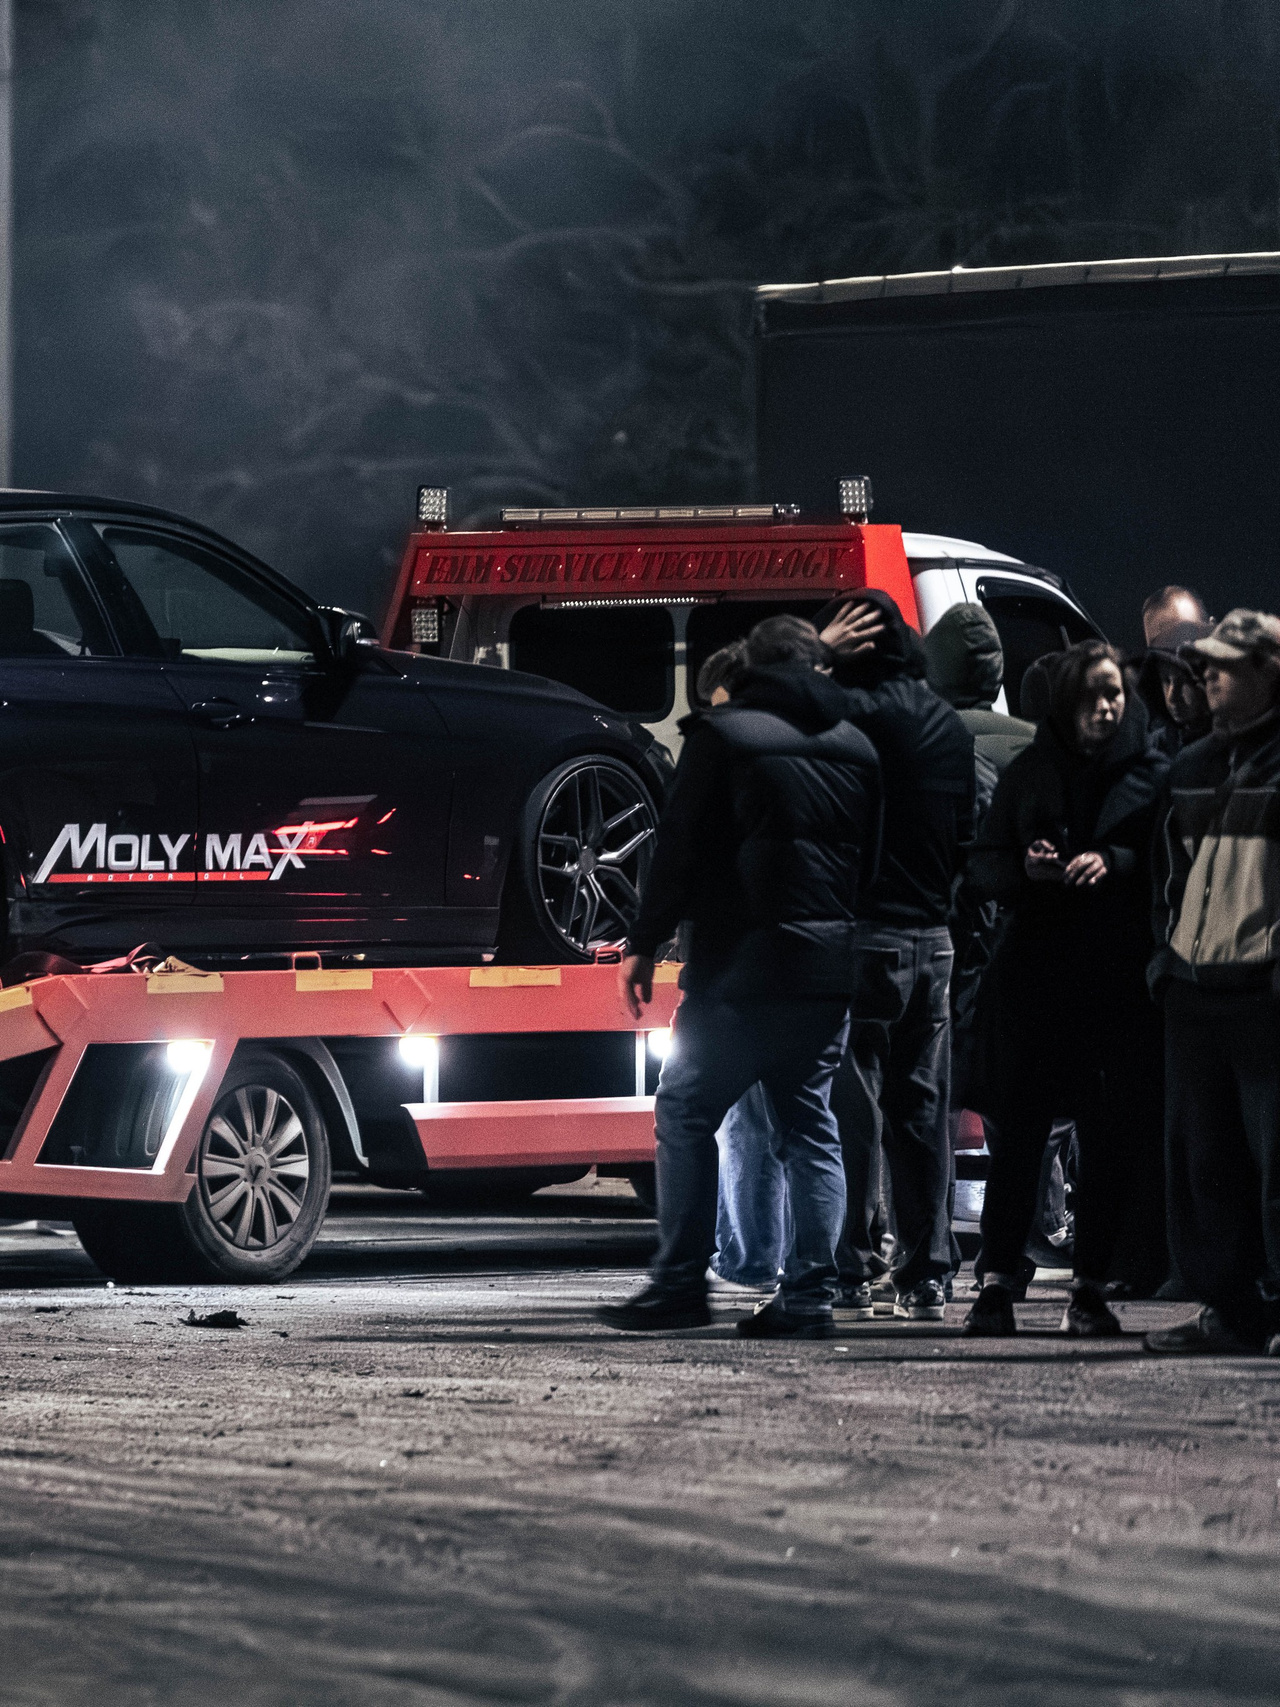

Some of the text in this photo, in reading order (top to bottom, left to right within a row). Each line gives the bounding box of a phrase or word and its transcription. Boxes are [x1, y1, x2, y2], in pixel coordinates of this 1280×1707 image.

[500, 552, 634, 583] SERVICE
[638, 547, 845, 580] TECHNOLOGY
[86, 872, 245, 882] MOTOR OIL
